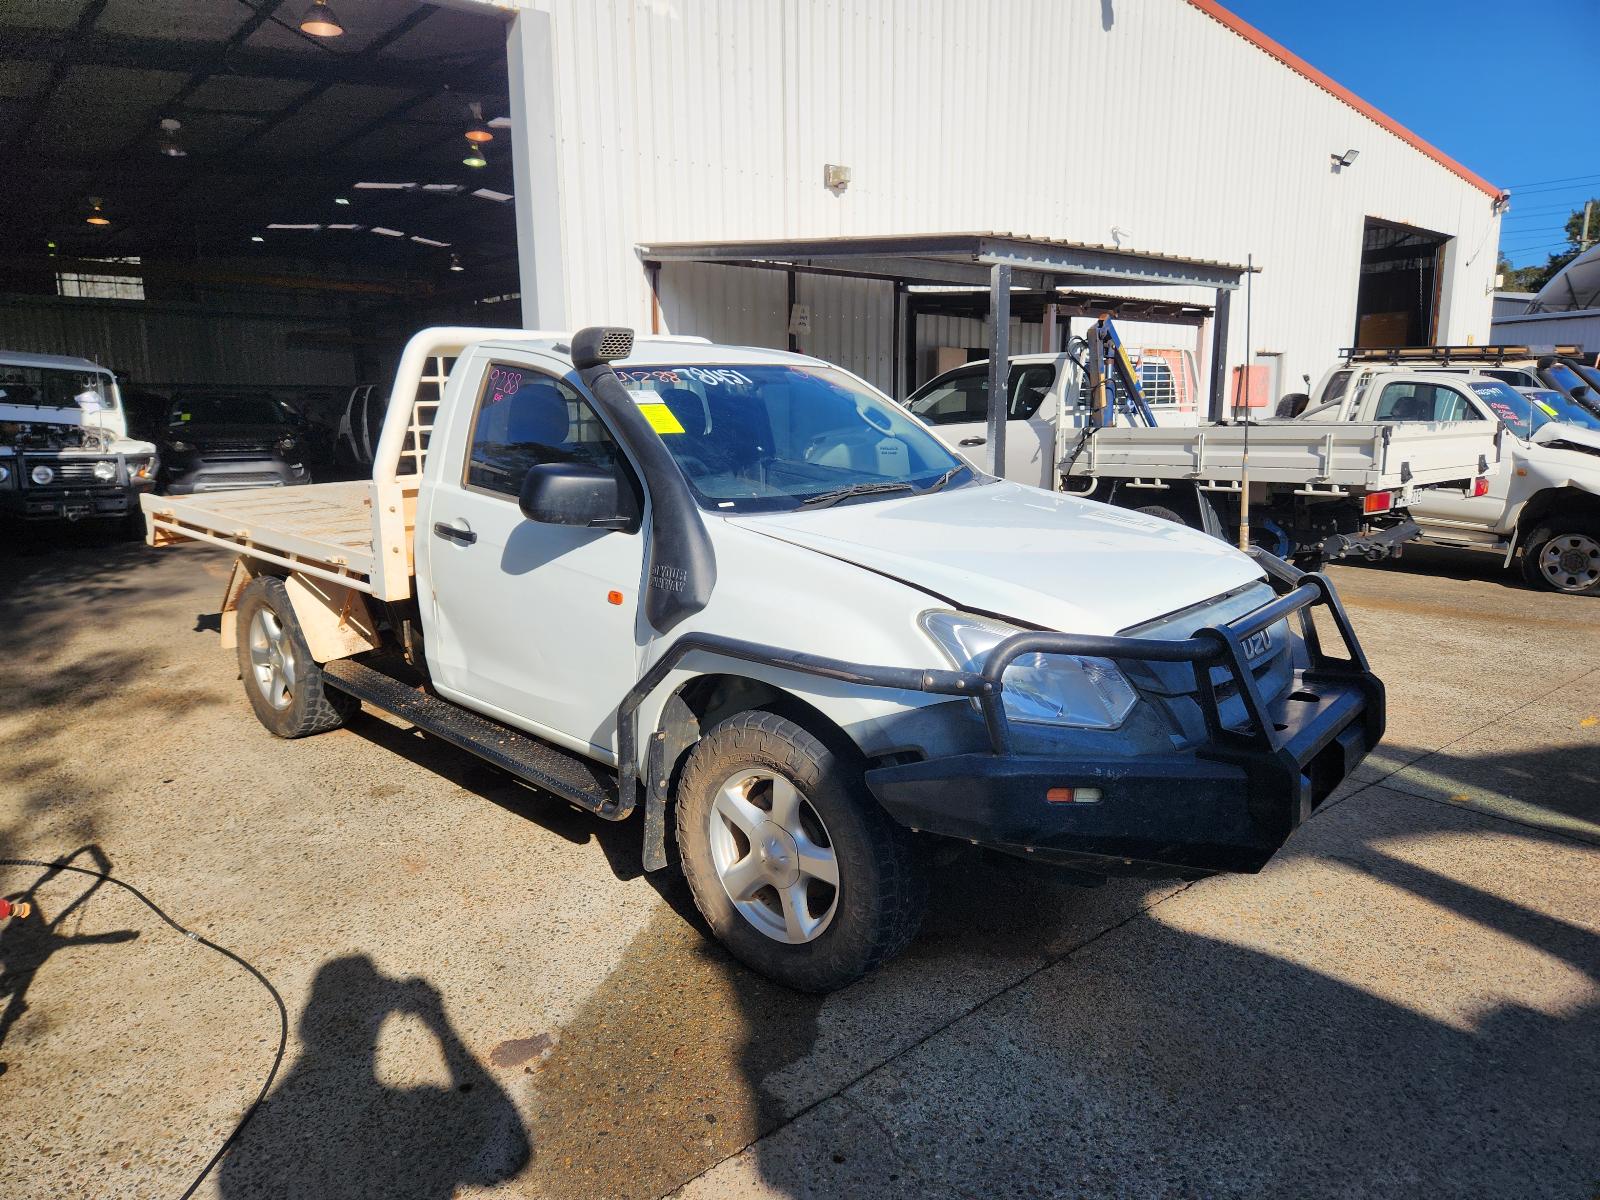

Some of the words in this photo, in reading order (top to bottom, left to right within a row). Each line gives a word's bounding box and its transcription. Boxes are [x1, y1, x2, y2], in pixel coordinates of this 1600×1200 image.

[490, 369, 522, 395] 9288
[671, 366, 754, 386] 78451
[1240, 627, 1273, 660] UZU
